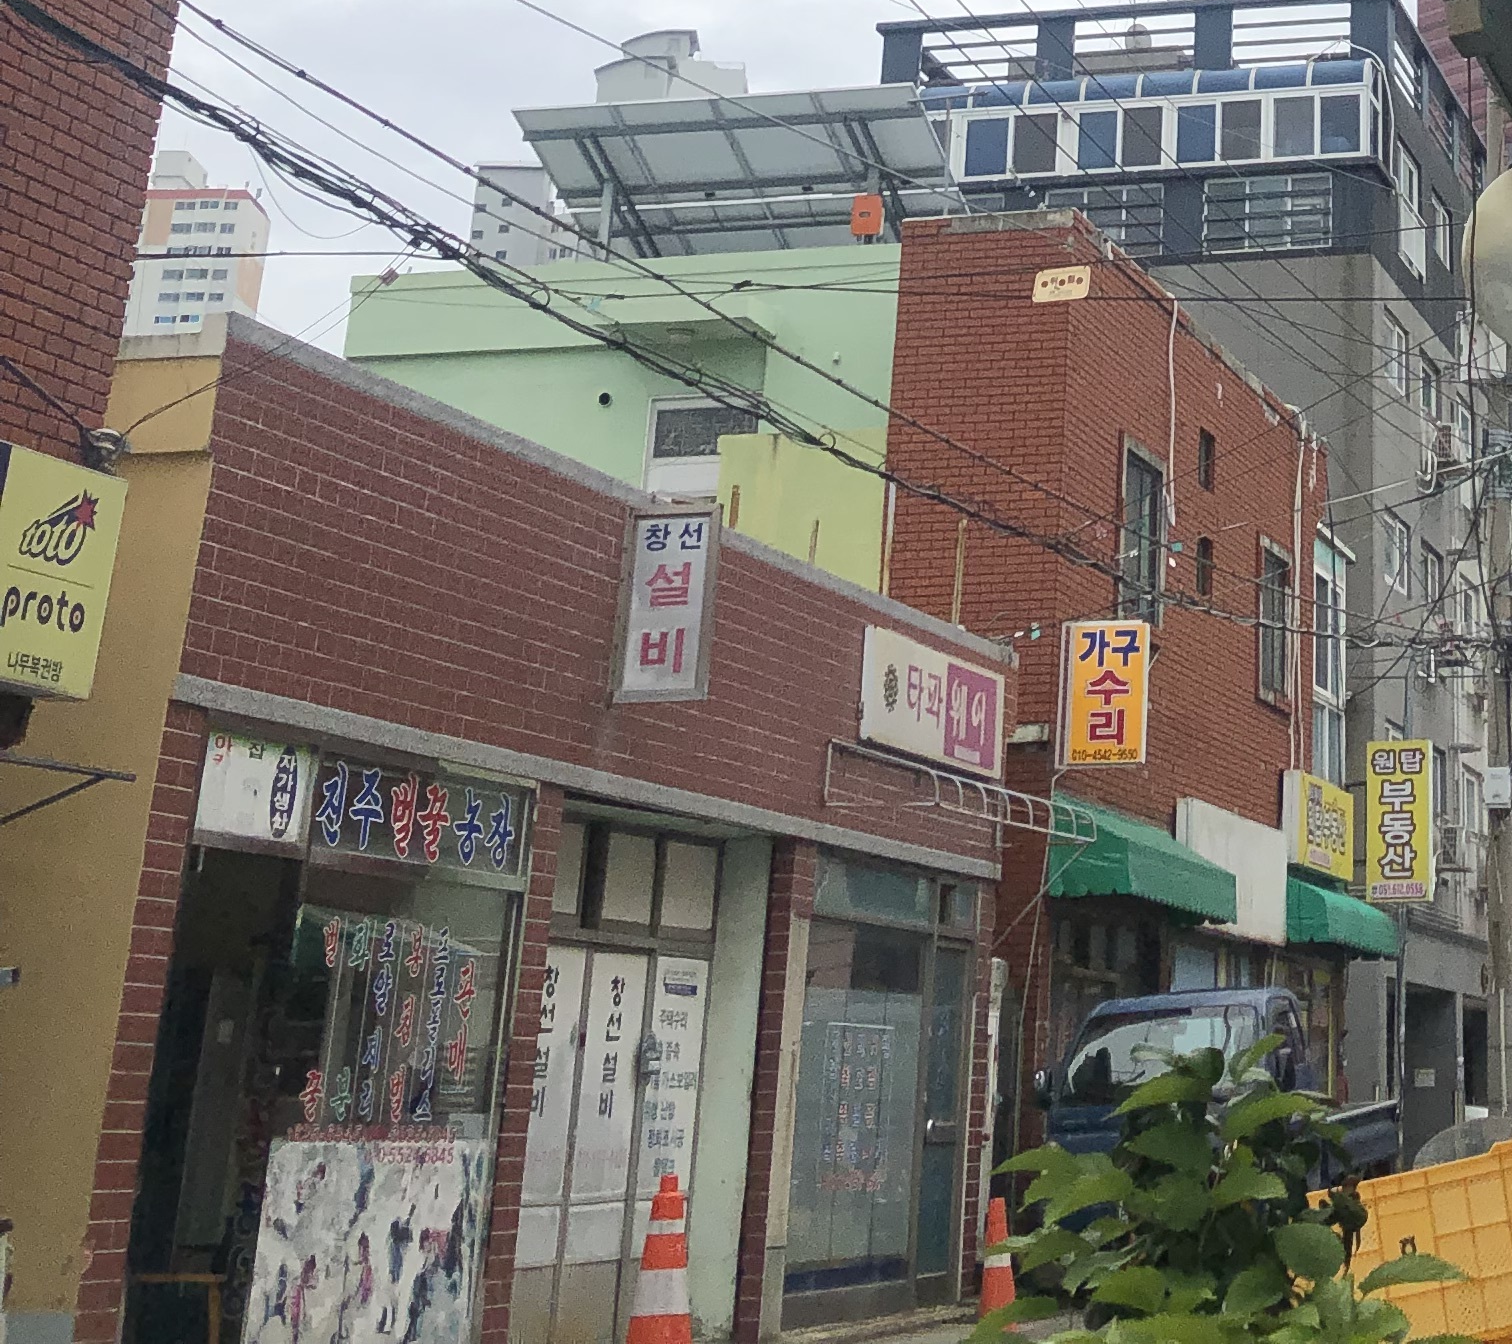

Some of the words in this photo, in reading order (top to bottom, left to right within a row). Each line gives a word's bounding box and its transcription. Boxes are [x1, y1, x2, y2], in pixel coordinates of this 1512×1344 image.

[644, 522, 704, 552] 창선
[0, 586, 85, 633] proto
[639, 562, 692, 674] 설비
[7, 651, 63, 683] 나무복권방
[1078, 629, 1141, 668] 가구
[1085, 669, 1132, 747] 수리
[1371, 747, 1425, 775] 원탑
[1377, 779, 1418, 879] 부동산
[598, 976, 626, 1119] 창선설비
